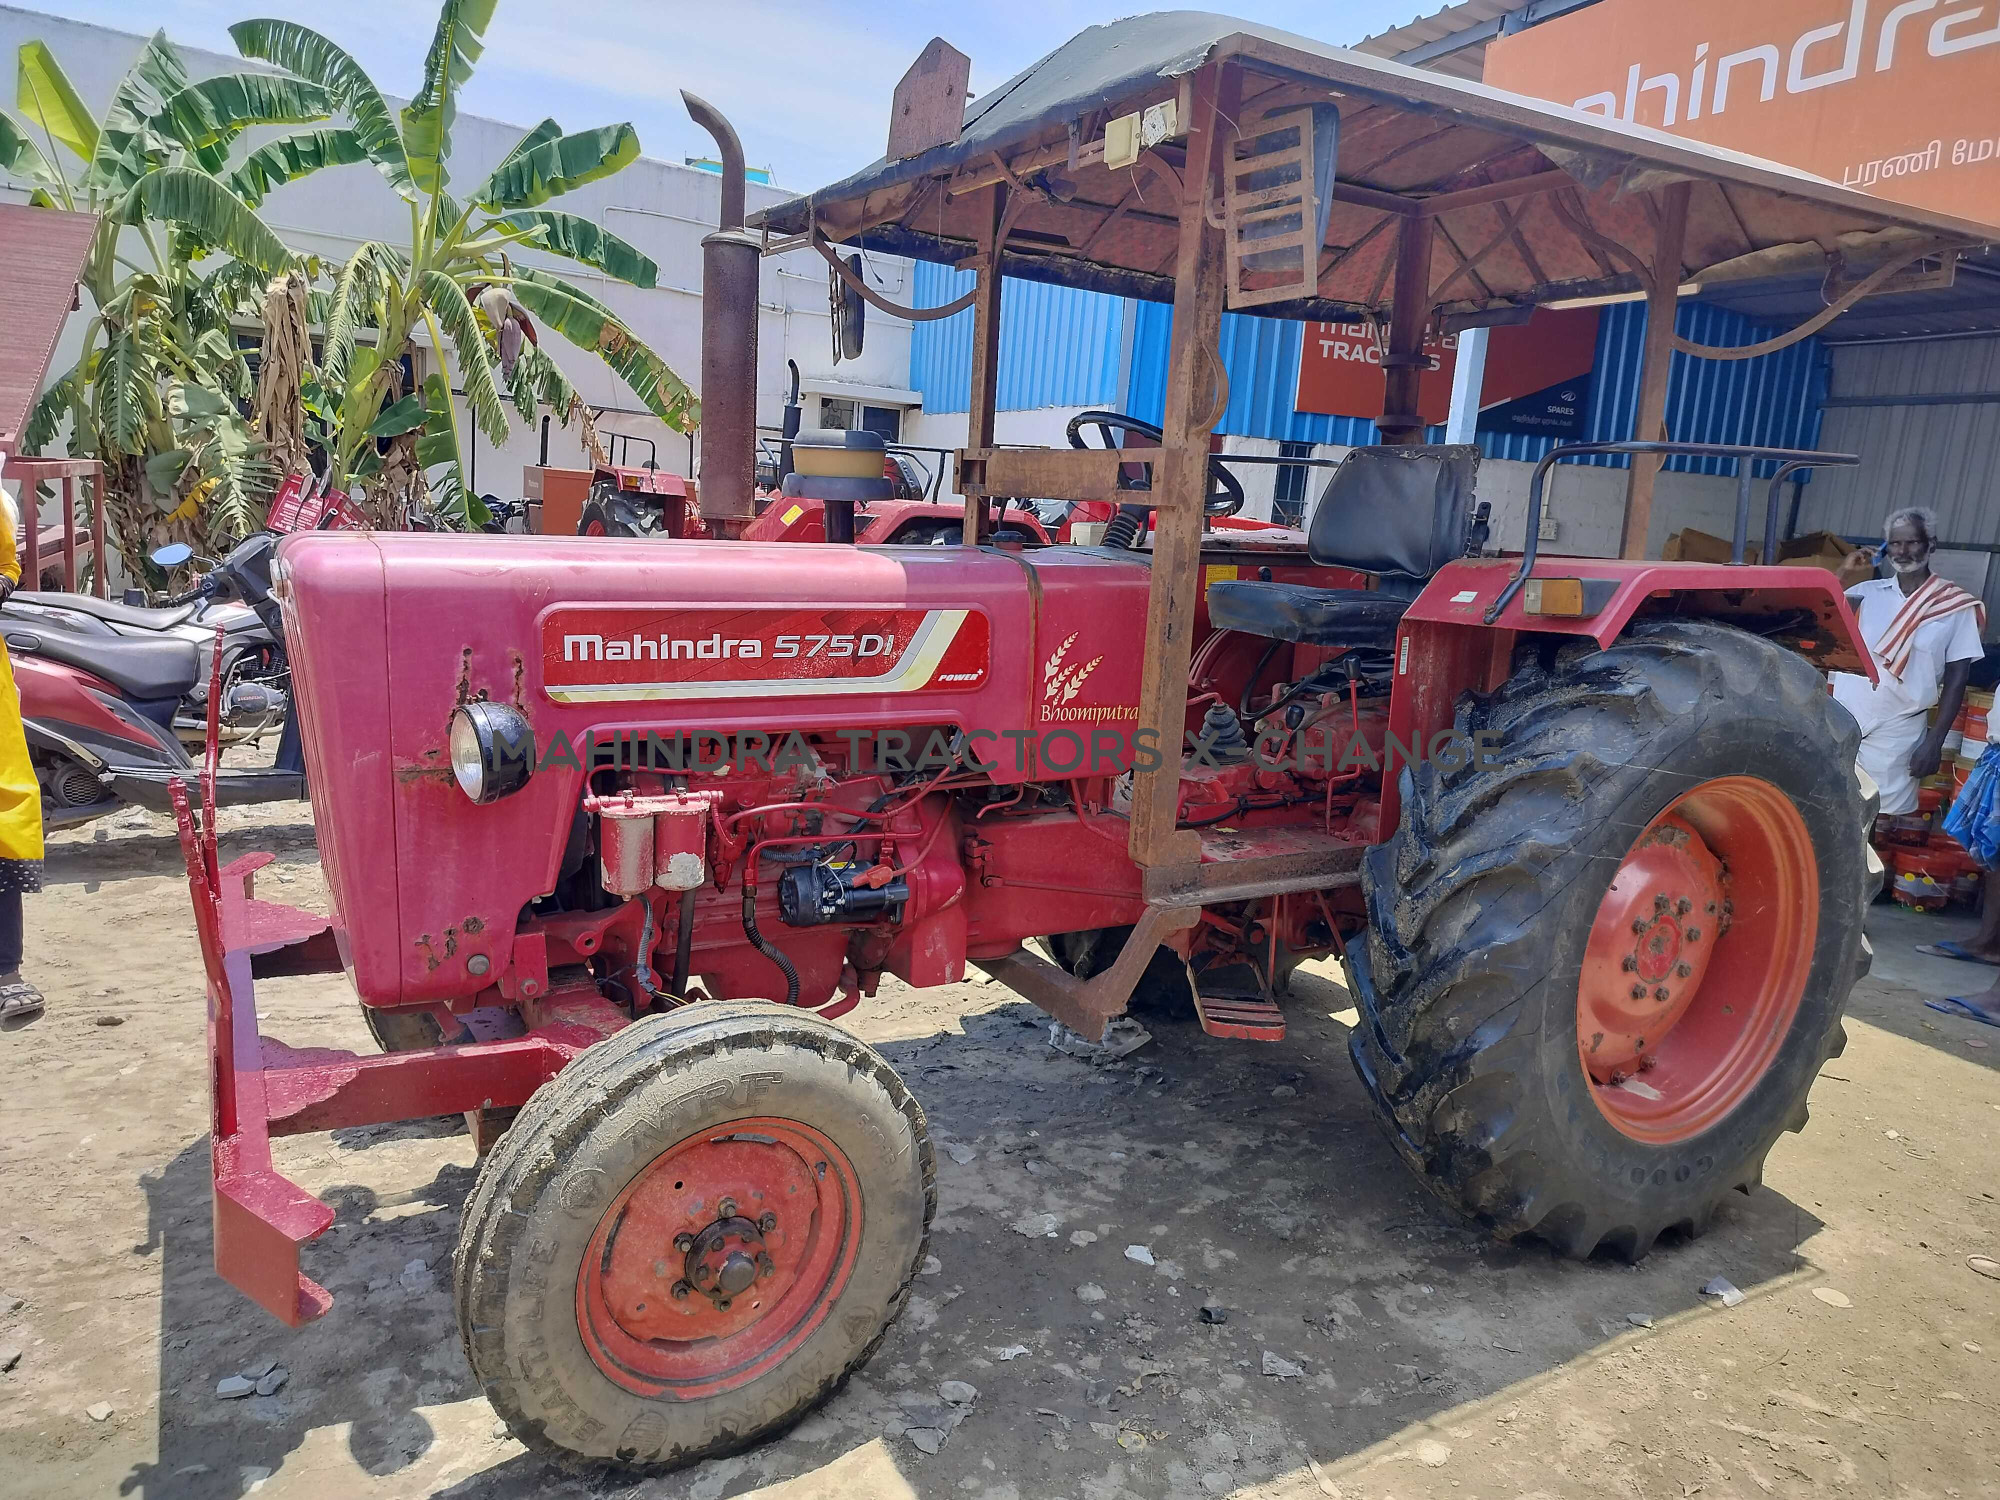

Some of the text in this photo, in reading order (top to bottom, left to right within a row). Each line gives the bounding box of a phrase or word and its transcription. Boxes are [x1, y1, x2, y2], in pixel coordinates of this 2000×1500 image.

[1319, 339, 1441, 371] TRACS
[1547, 405, 1574, 415] SPARES
[564, 634, 762, 661] Mahindra
[1040, 702, 1139, 727] Bhoomiputra
